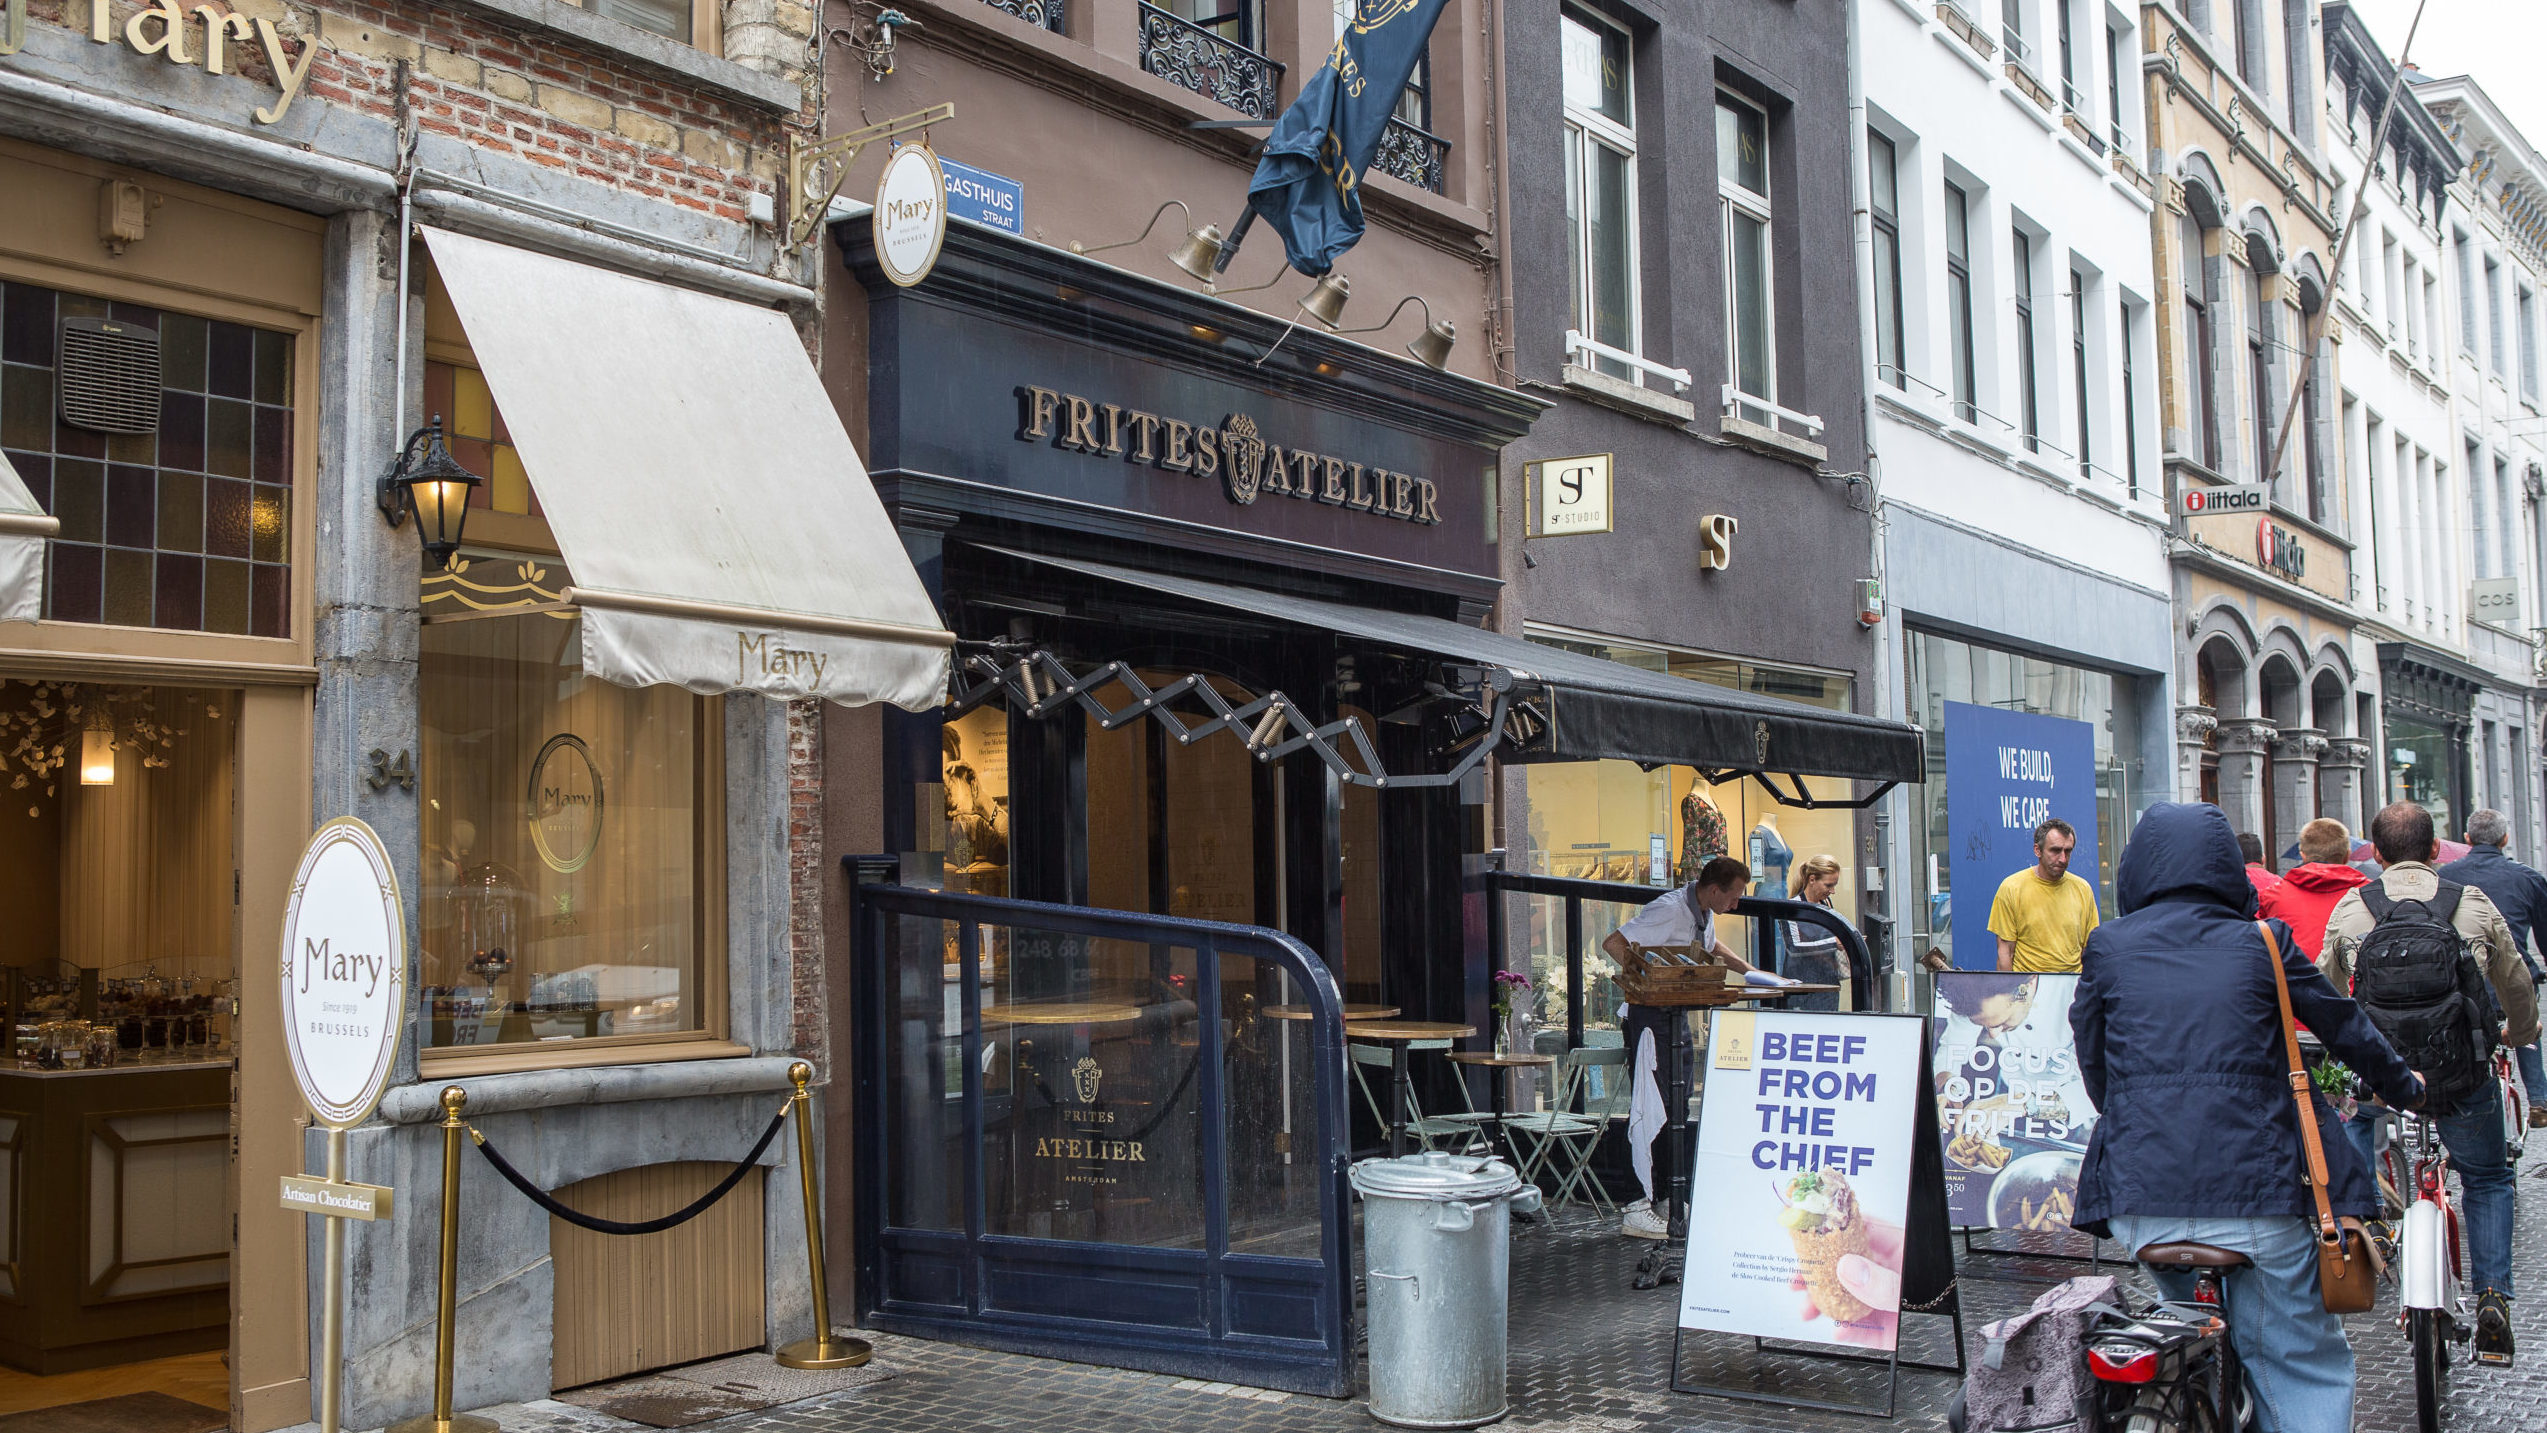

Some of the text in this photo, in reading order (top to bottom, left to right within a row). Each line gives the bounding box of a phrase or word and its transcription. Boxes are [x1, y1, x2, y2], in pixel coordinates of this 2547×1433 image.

[944, 173, 1014, 212] GASTHUIS
[886, 198, 934, 231] Mary
[982, 209, 1014, 229] STRAAT
[1023, 385, 1443, 527] FRITES ATELIER
[2207, 490, 2261, 510] iittala
[1565, 511, 1600, 524] STUDIO
[2479, 593, 2514, 607] COS
[734, 631, 828, 692] Mary
[367, 748, 415, 789] 34
[1998, 746, 2055, 790] WE BUILD,
[2000, 796, 2020, 828] WE
[300, 936, 384, 999] Mary
[322, 1001, 341, 1013] Since
[311, 1021, 370, 1039] BRUSSELS
[1762, 1032, 1867, 1064] BEEF
[1945, 1044, 2071, 1076] FOCUS
[1758, 1067, 1877, 1103] FROM
[1944, 1076, 2058, 1107] OP DE
[1063, 1110, 1115, 1124] FRITES
[1756, 1104, 1836, 1137] THE
[1942, 1107, 2070, 1140] FRITES
[1035, 1137, 1146, 1162] ATELIER
[1751, 1140, 1875, 1176] CHIEF
[1065, 1175, 1117, 1184] AMSTERDAM
[282, 1185, 372, 1212] Artisan Chocolatier
